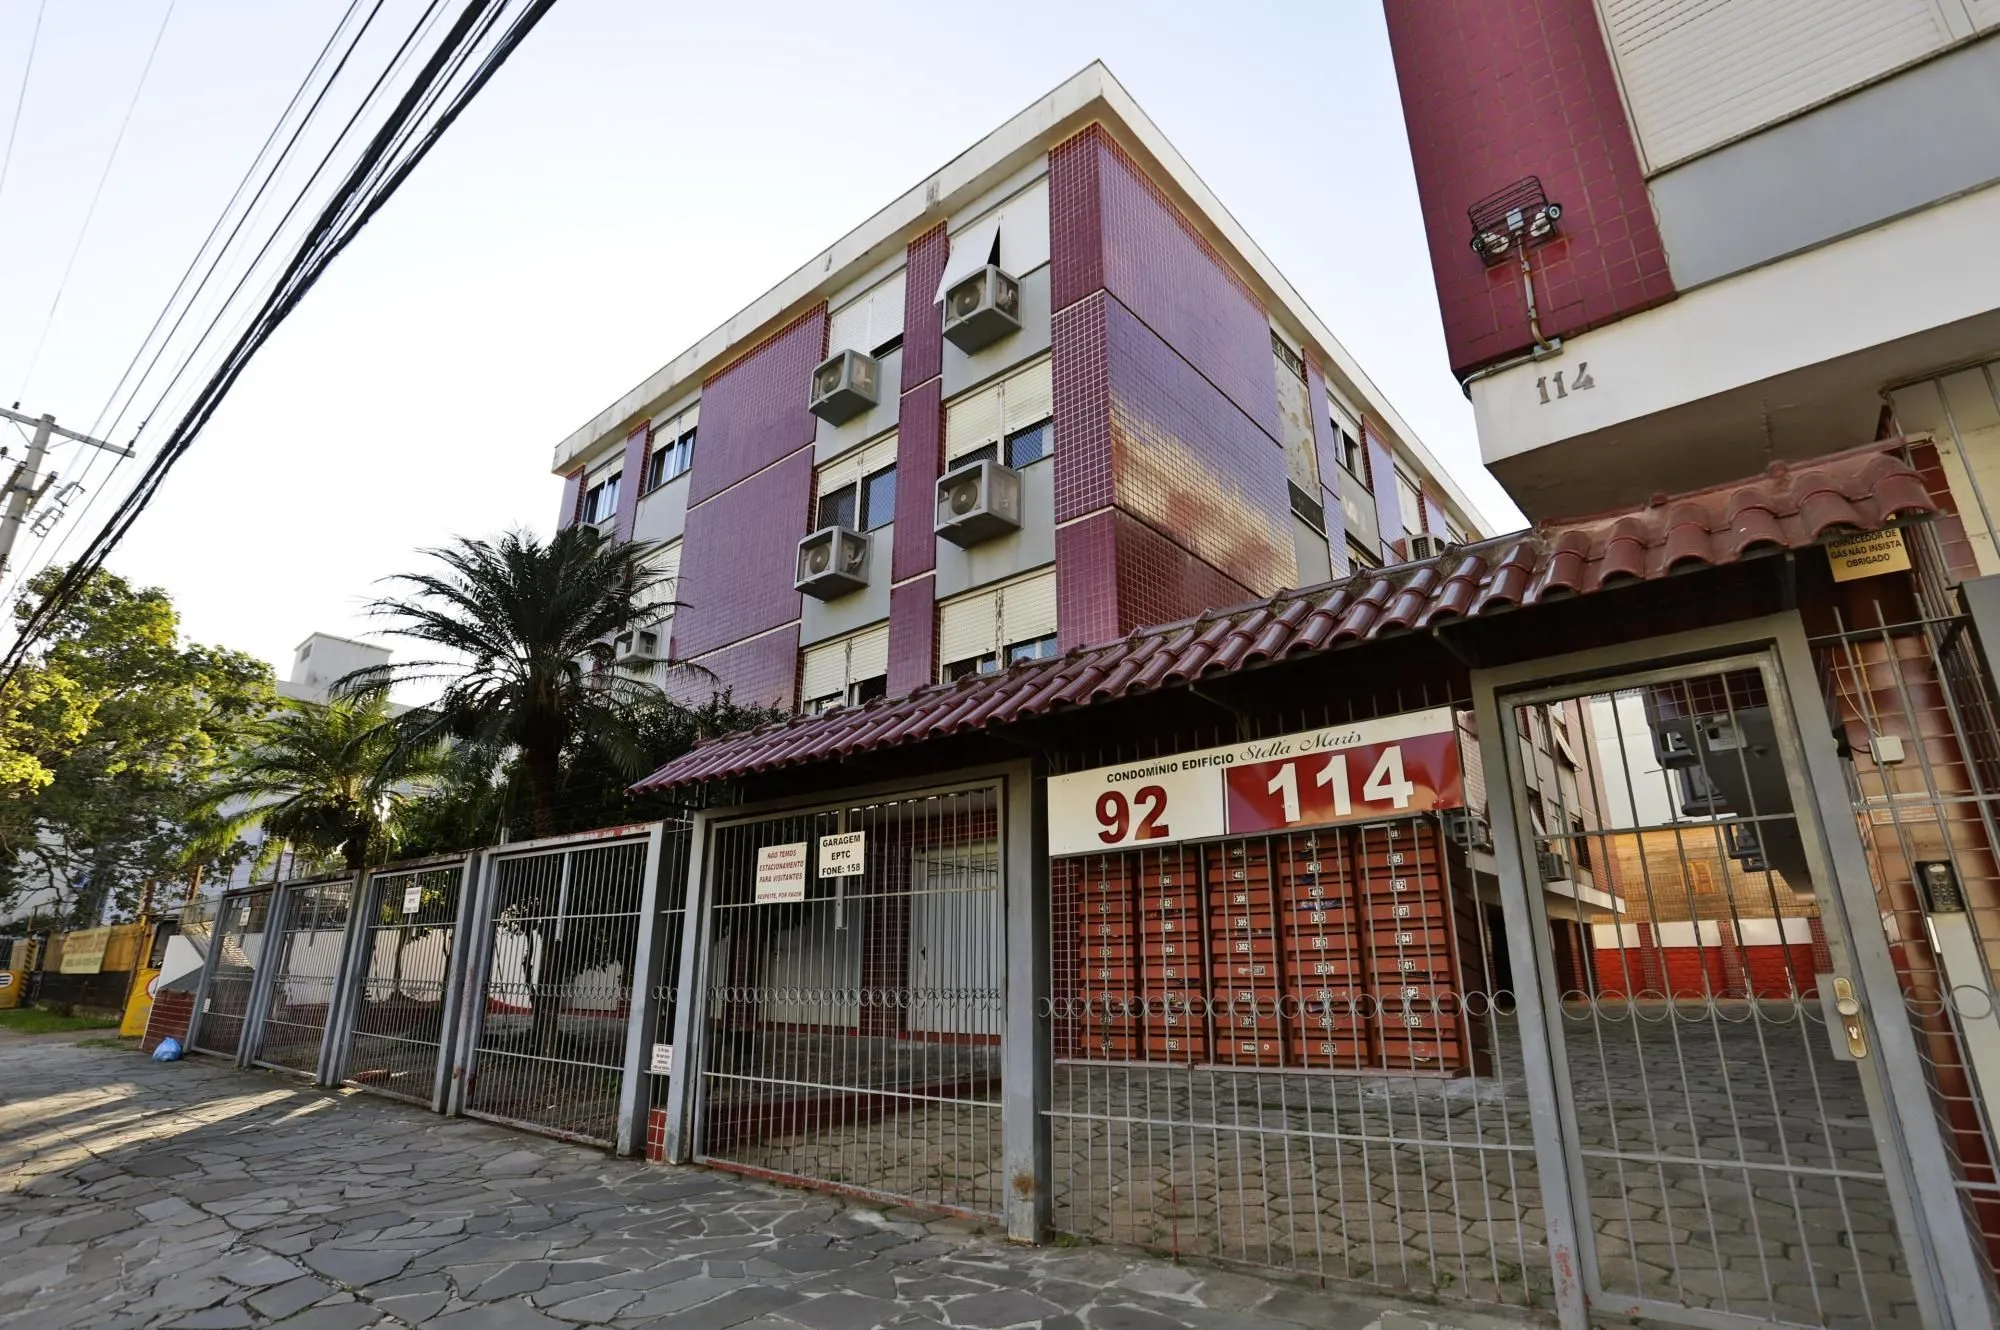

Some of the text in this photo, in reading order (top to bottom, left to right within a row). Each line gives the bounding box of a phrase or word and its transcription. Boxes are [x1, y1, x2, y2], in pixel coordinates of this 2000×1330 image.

[1536, 362, 1596, 405] 114
[1886, 530, 1897, 538] DE
[1868, 540, 1902, 552] INSISTA
[1846, 554, 1890, 568] OBRIGADO
[1106, 730, 1362, 783] CONDOMÍNIO EDIFÍCIO Stella Maris
[1267, 745, 1415, 823] 114
[1095, 785, 1170, 844] 92
[822, 834, 861, 848] GARAGEM
[780, 850, 797, 858] TEMOS
[831, 850, 851, 860] EPTC
[759, 860, 804, 872] ESTACIONAMENTO
[822, 863, 861, 876] FONE: 158
[773, 872, 803, 882] VISITANTES
